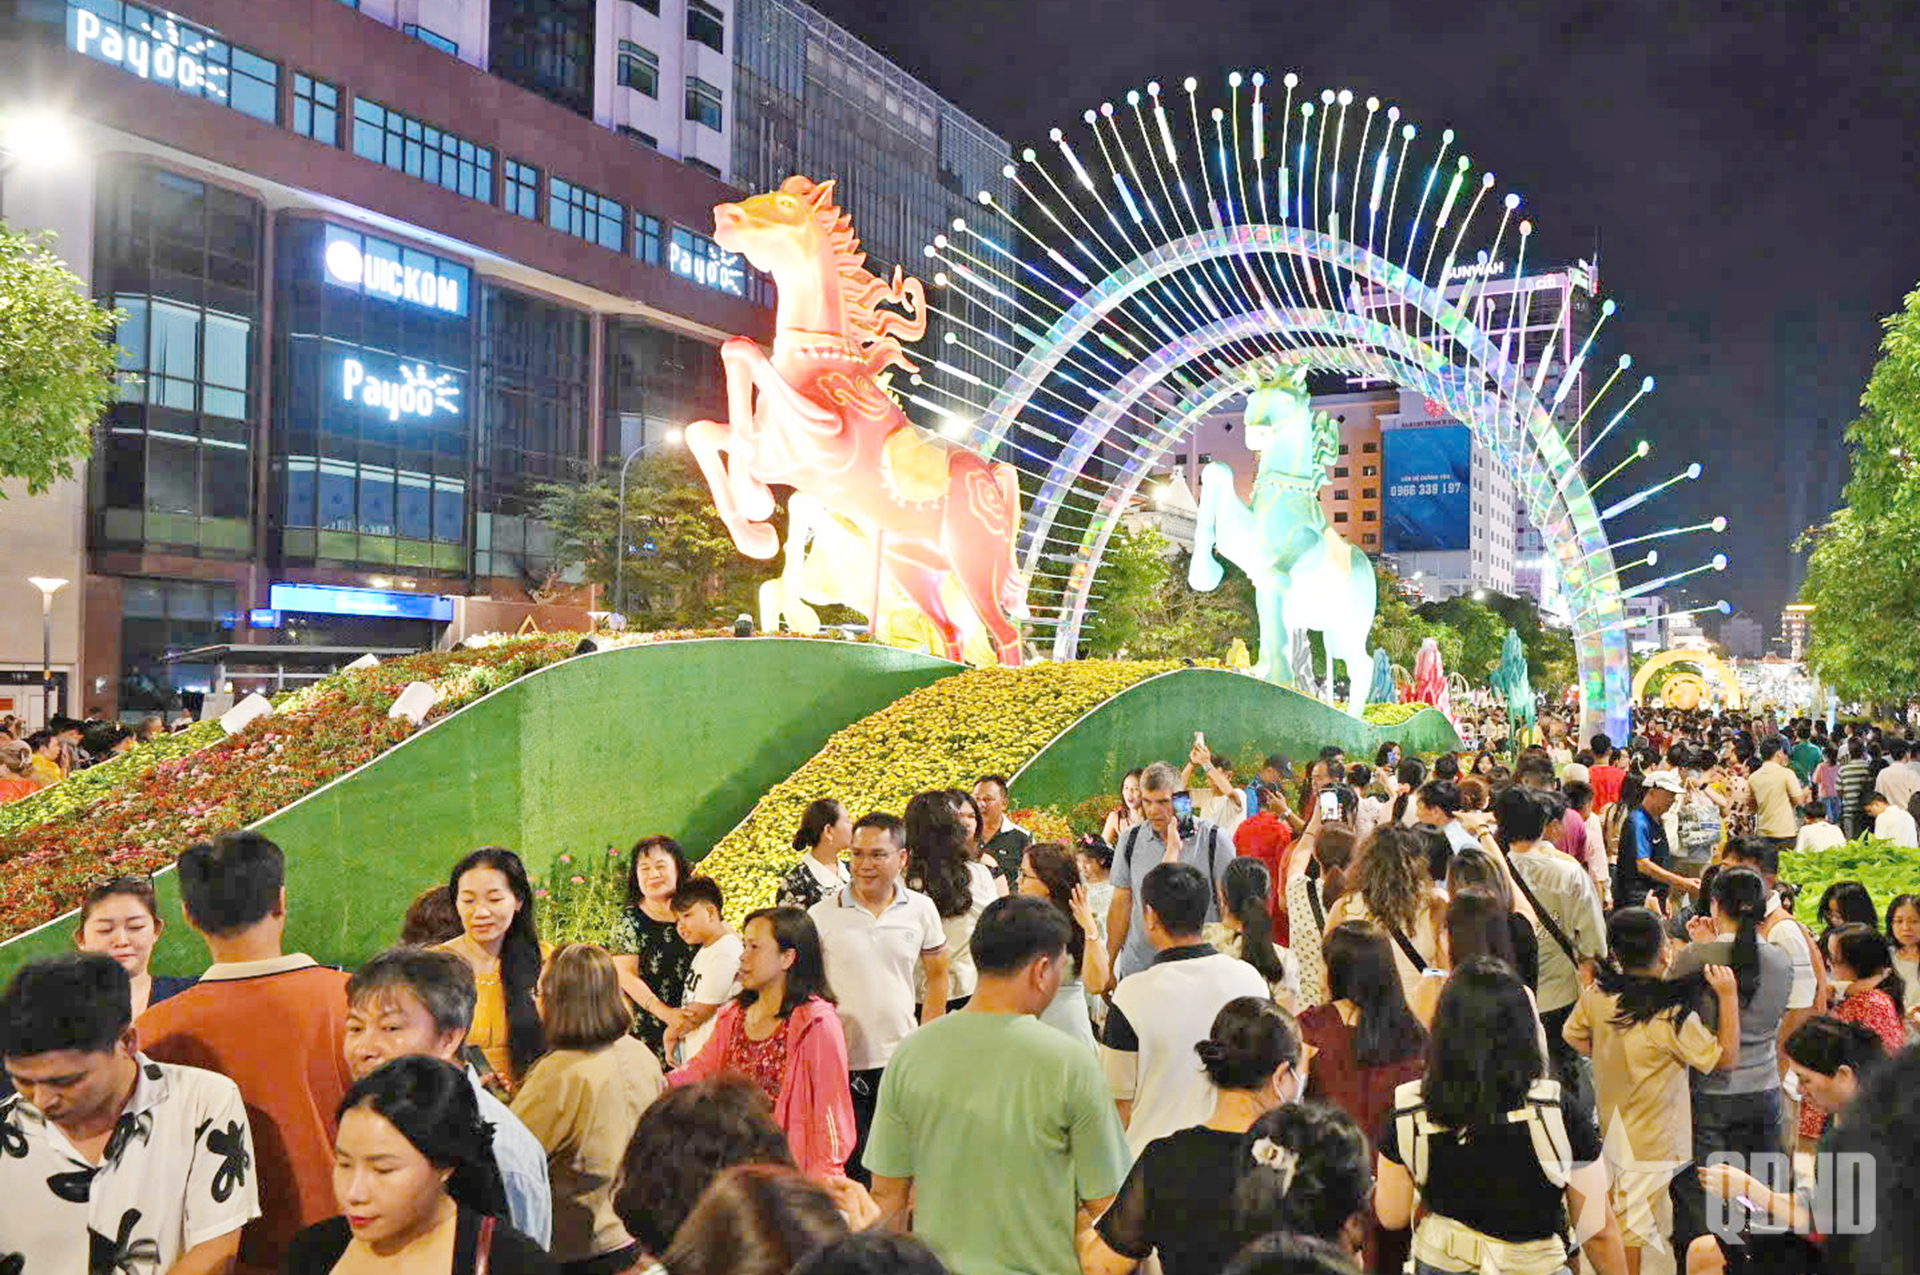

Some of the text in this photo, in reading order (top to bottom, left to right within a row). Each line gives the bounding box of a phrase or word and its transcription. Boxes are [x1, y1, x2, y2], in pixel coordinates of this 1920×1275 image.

[76, 8, 197, 87] Payoo
[669, 241, 730, 288] Payoo
[343, 359, 434, 421] Payoo
[1442, 482, 1461, 494] 197
